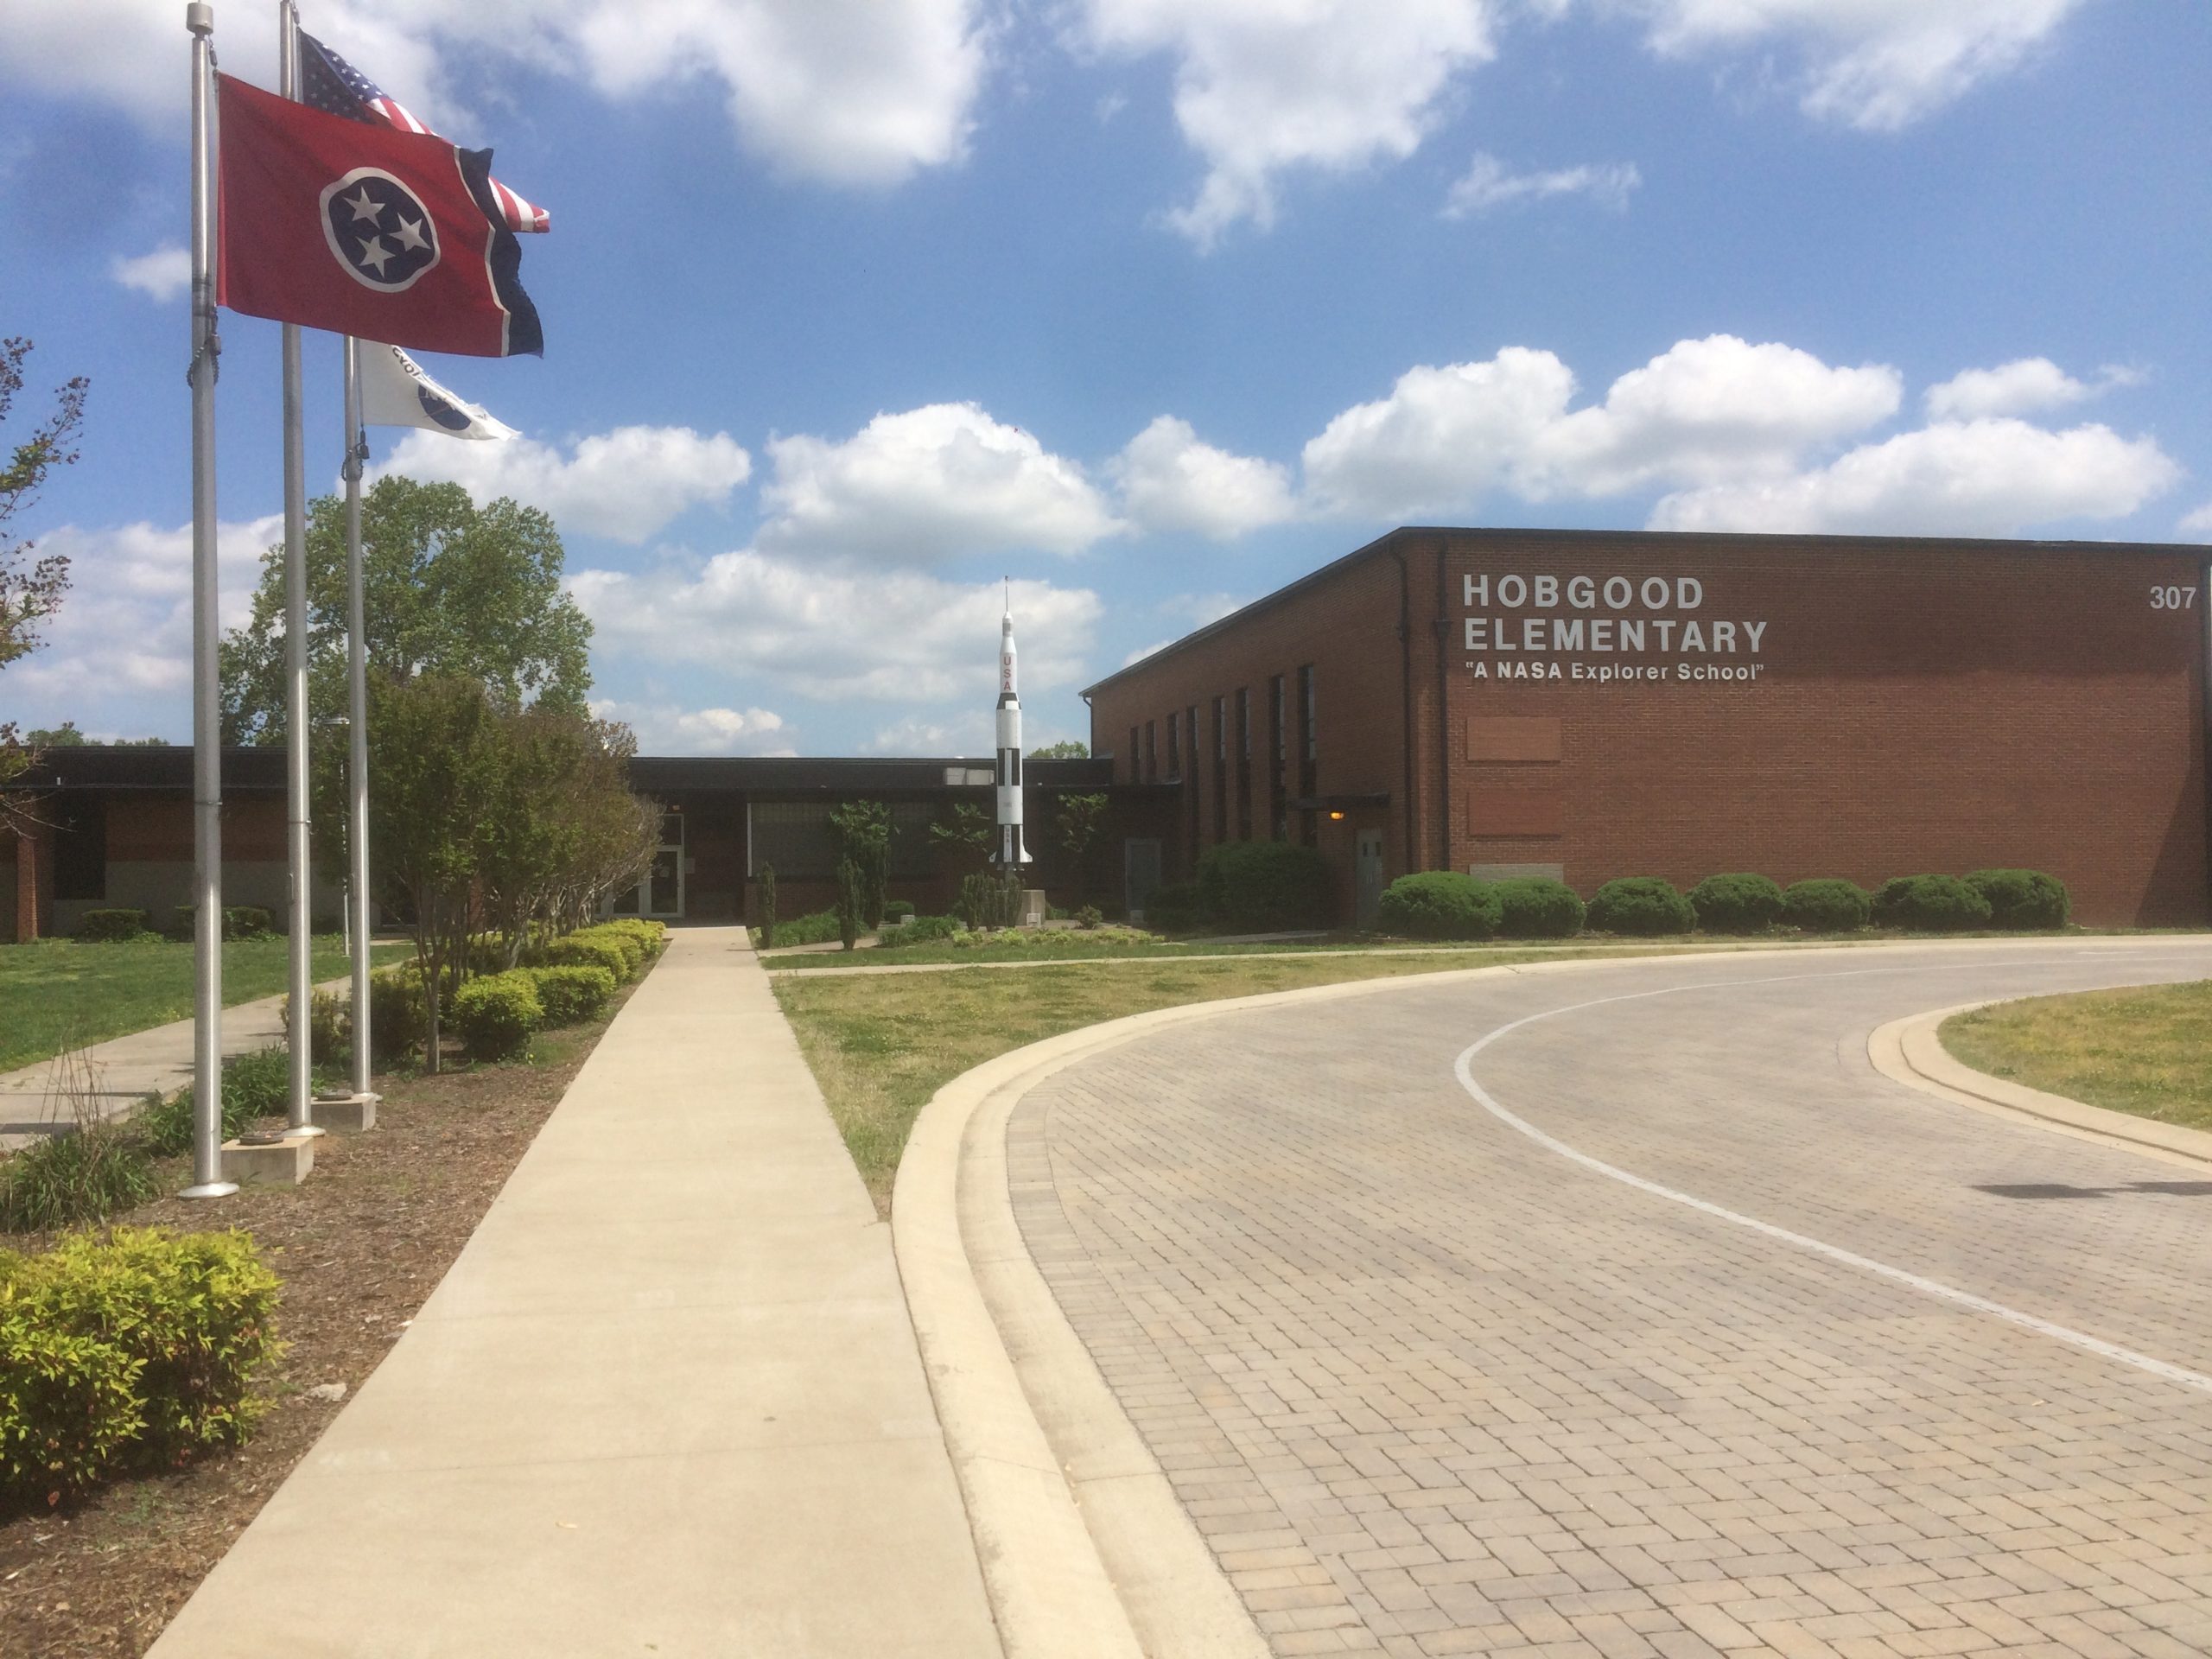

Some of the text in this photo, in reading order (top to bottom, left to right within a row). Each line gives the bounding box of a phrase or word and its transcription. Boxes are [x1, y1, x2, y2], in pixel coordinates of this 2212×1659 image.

[1464, 574, 1703, 609] HOBGOOD
[2150, 586, 2196, 610] 307
[1465, 618, 1767, 652] ELEMENTARY
[1003, 656, 1012, 690] USA
[1497, 662, 1562, 679] NASA
[1572, 662, 1669, 683] Explorer
